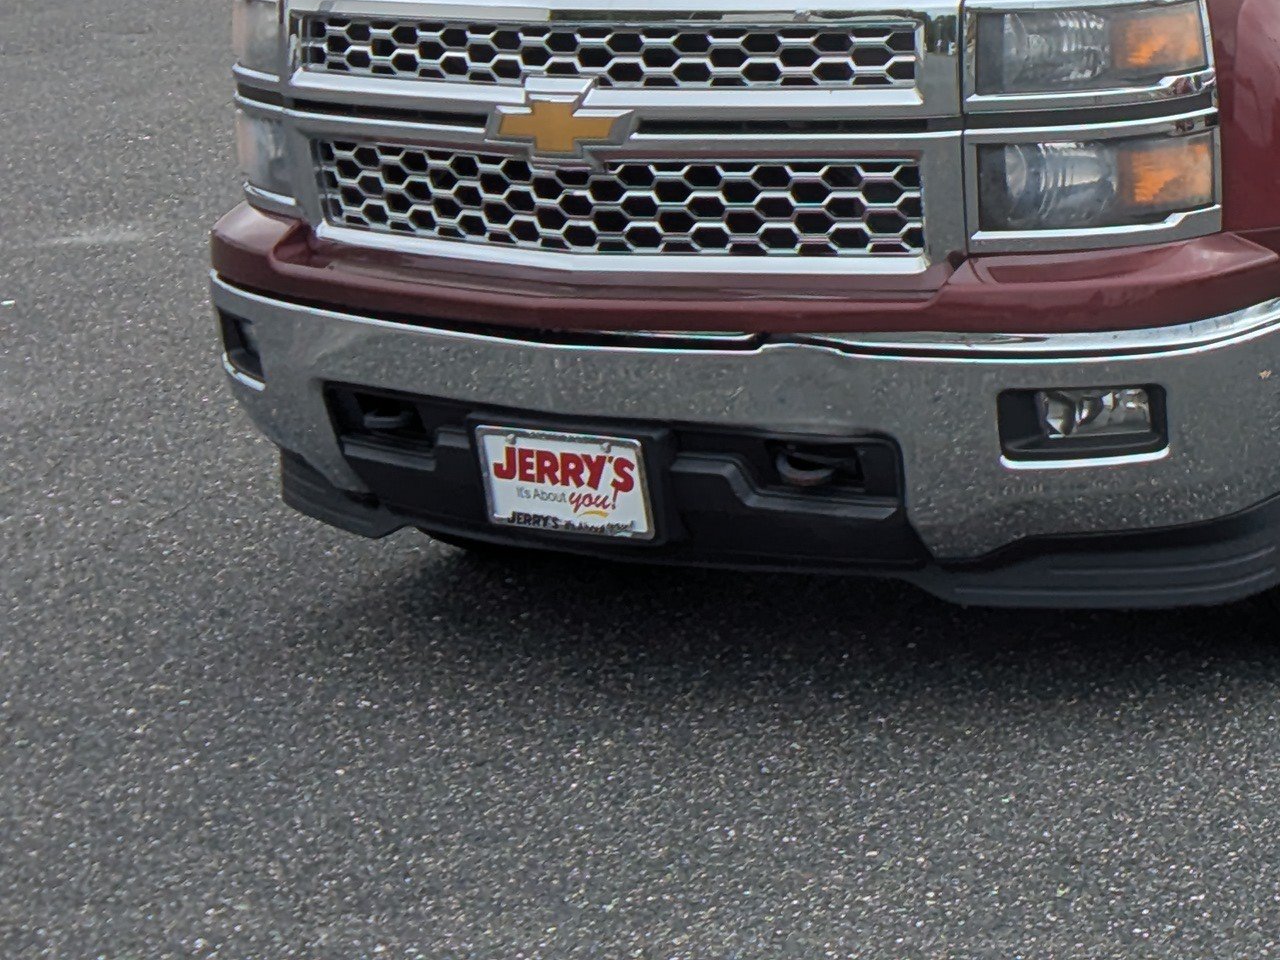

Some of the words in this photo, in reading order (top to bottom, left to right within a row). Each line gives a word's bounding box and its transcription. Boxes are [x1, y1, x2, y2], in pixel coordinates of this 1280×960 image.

[493, 446, 635, 493] JERRY'S
[533, 488, 568, 503] About
[568, 488, 618, 513] you!
